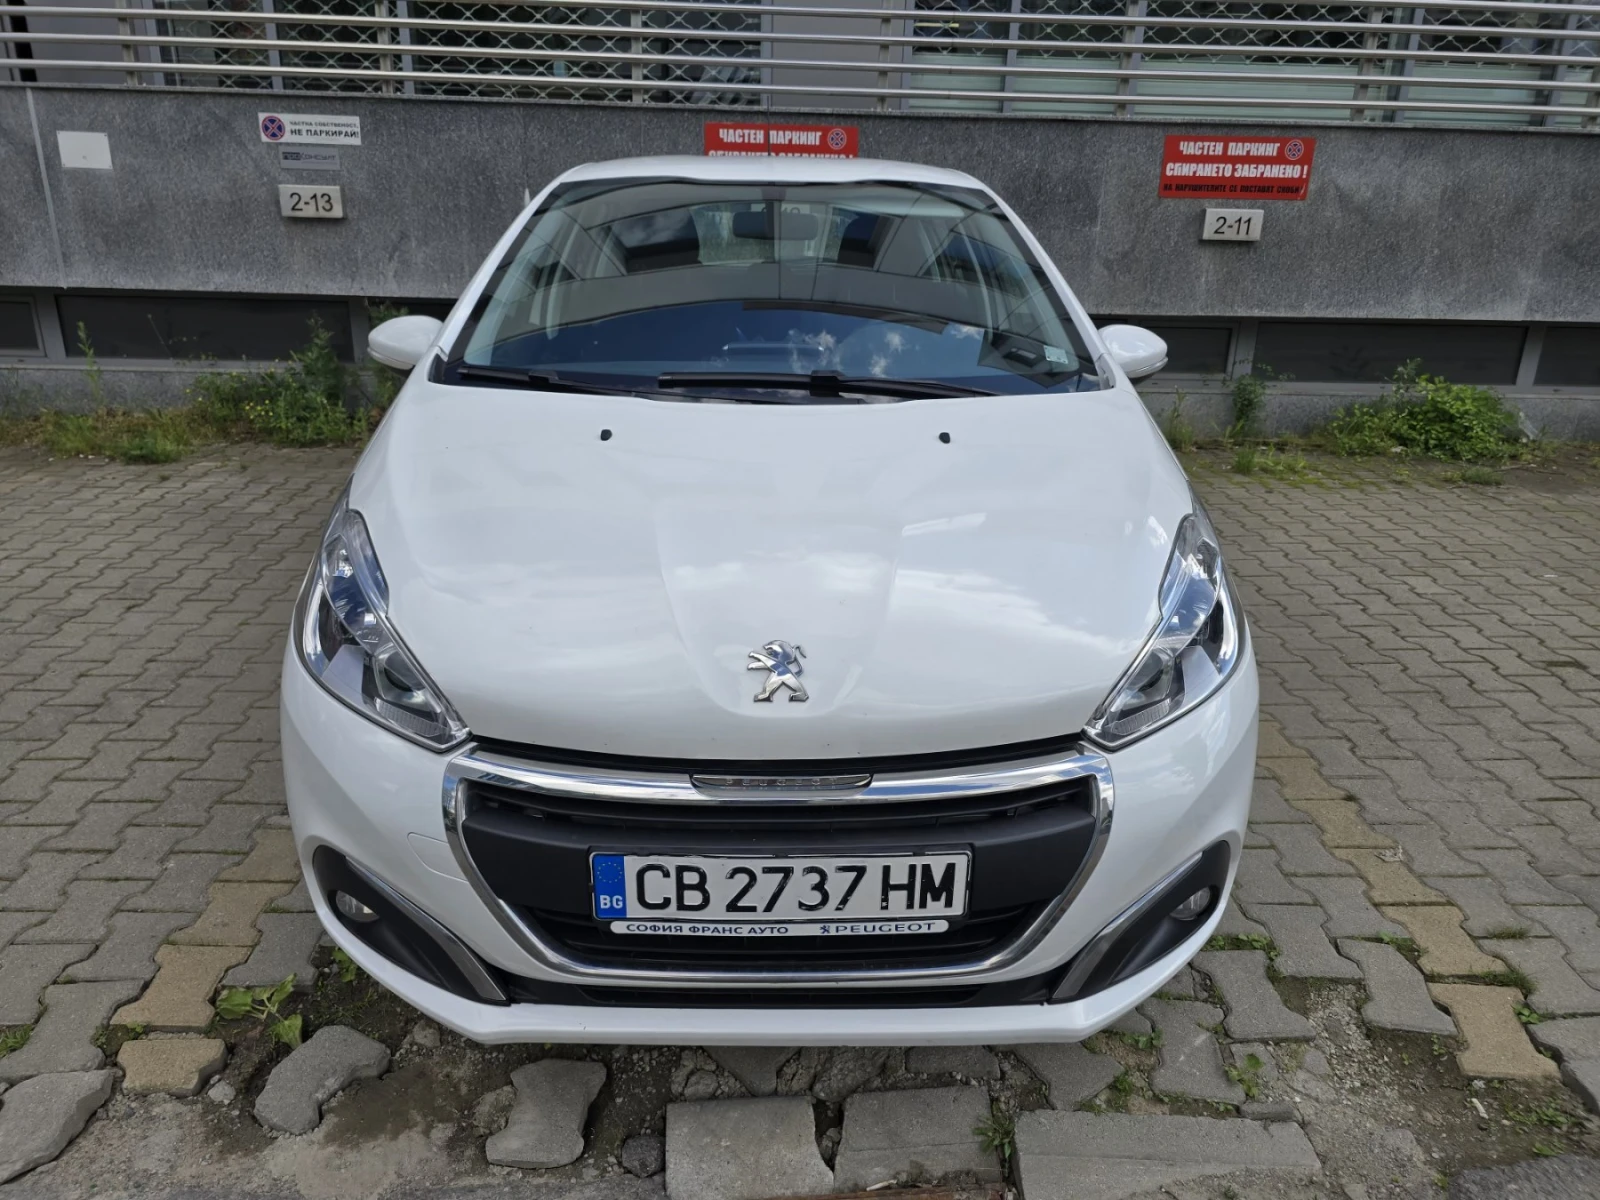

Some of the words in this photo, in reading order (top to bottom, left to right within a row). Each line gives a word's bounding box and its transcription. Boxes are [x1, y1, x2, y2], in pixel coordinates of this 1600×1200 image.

[290, 128, 303, 136] НЕ
[306, 128, 360, 138] ПАРКИРАЙ!
[719, 128, 765, 144] ЧАСТЕН
[769, 130, 822, 146] ПАРКИНГ
[1179, 141, 1224, 156] ЧАСТЕН
[1227, 141, 1281, 157] ПАРКИНГ
[1165, 162, 1233, 178] СПИРАНЕТО
[1234, 163, 1301, 179] ЗАБРАНЕНО
[1163, 183, 1173, 191] НА
[1175, 183, 1227, 193] НАРУШИТЕЛИТЕ
[1229, 184, 1238, 193] СЕ
[289, 192, 334, 213] 2-13
[1213, 216, 1253, 236] 2-11
[635, 863, 711, 912] CB
[725, 865, 868, 913] 2737
[880, 862, 956, 911] HM
[600, 895, 623, 909] BG
[626, 923, 683, 933] СОФИЯ
[688, 924, 743, 935] ФРАНС
[749, 926, 789, 935] АУТО
[835, 922, 936, 934] PEUGEOT
